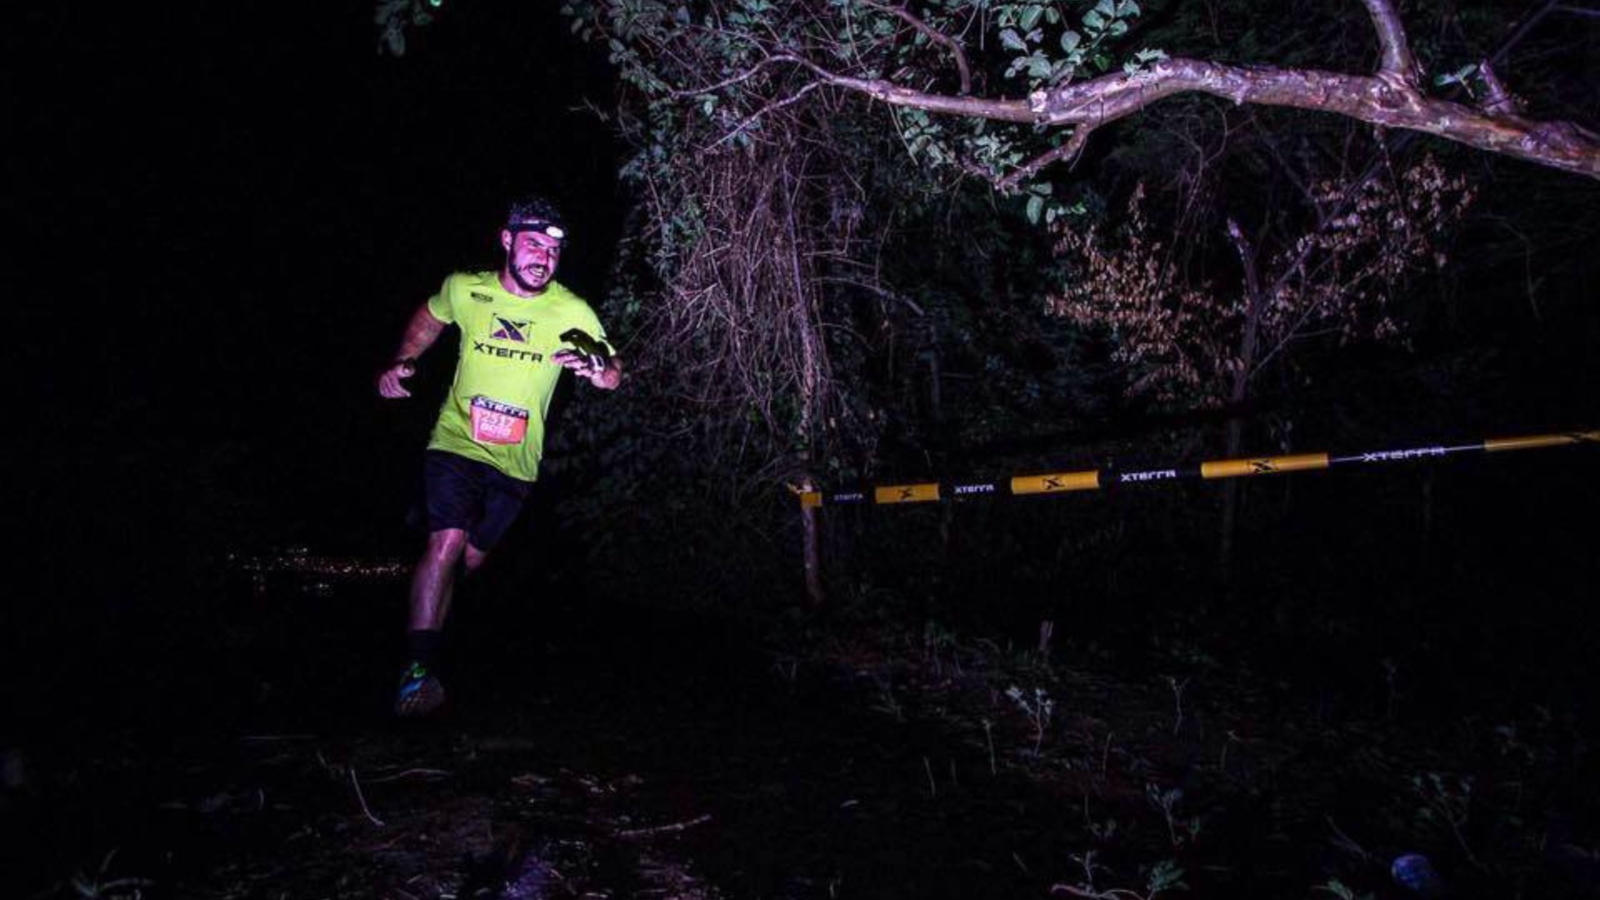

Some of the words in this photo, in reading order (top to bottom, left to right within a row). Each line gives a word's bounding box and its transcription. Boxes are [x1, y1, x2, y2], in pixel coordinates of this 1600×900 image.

[474, 341, 543, 362] XTERRA
[475, 397, 527, 417] XTERRA
[1363, 446, 1445, 462] XTERRA
[1121, 469, 1176, 482] XTERRA
[955, 484, 994, 495] XTERRA
